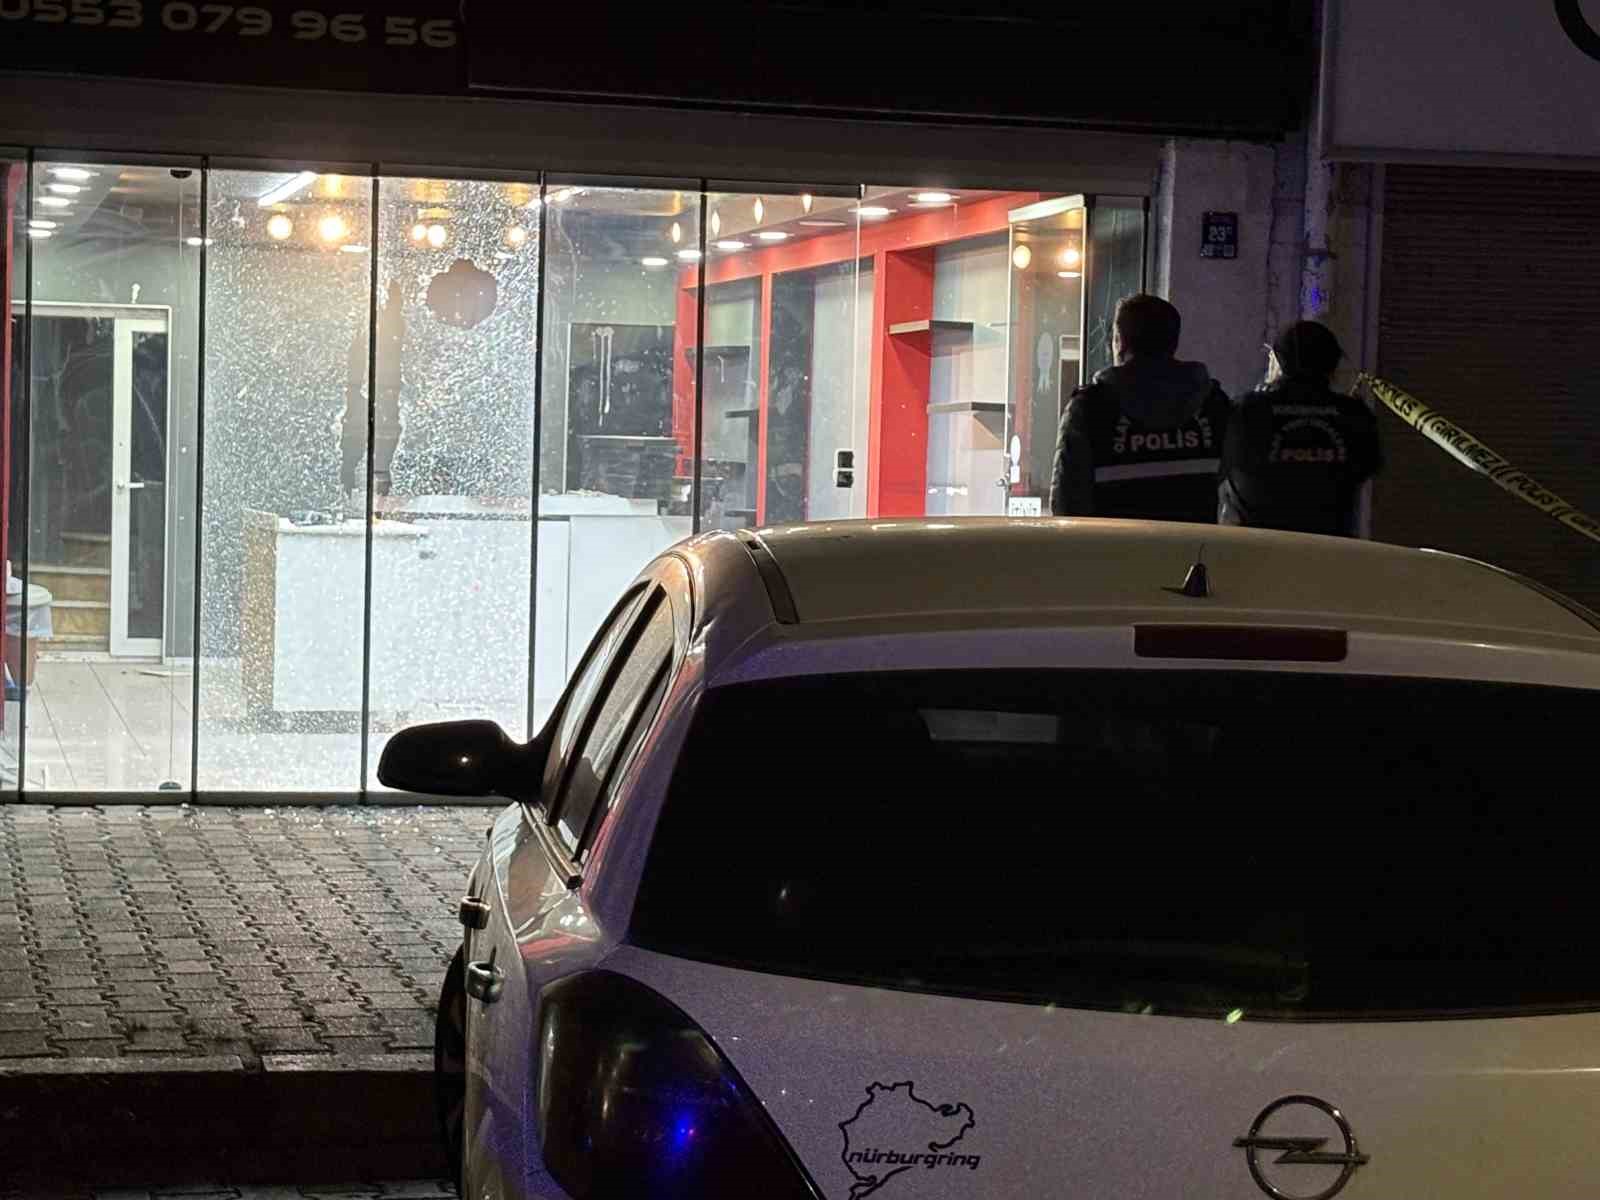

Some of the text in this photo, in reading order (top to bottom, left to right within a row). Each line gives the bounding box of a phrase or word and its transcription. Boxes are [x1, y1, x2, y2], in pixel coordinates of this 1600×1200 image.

[0, 0, 457, 48] 0553 079 96 56
[849, 1148, 980, 1170] nürburgring
